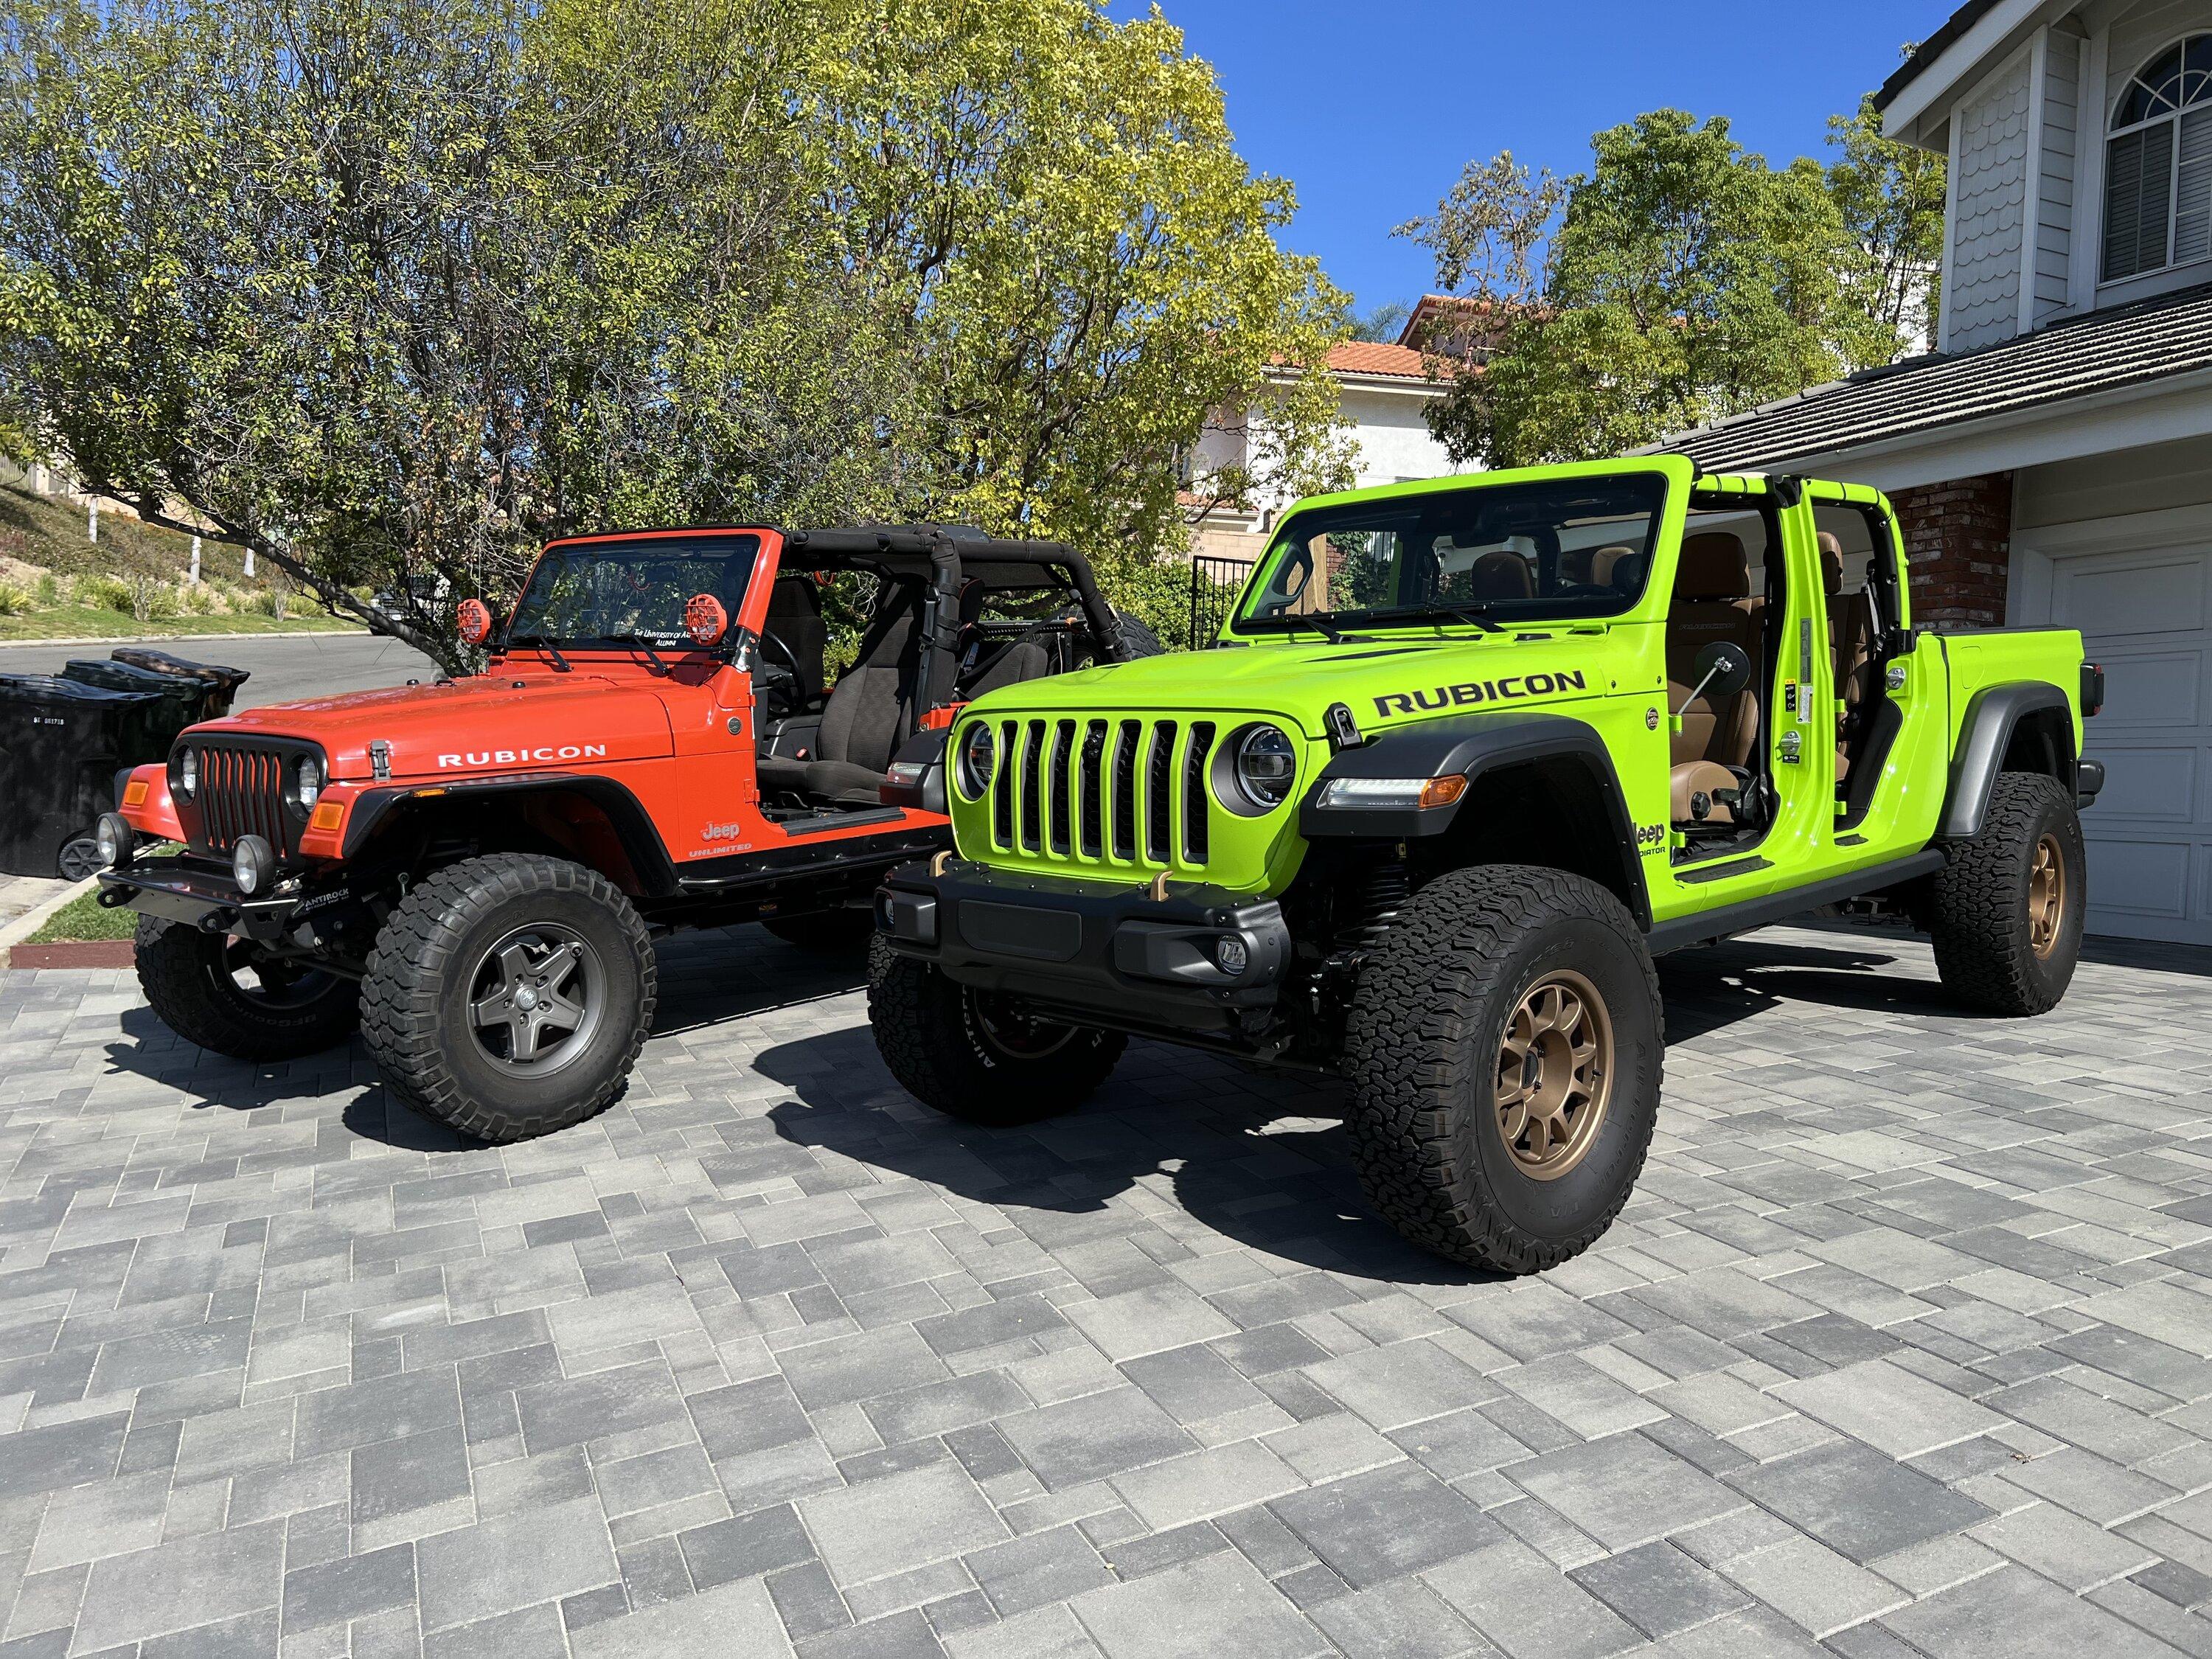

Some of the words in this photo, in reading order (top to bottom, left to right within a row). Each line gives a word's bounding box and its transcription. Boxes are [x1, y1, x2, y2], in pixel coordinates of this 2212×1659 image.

[644, 629, 674, 639] UNIVERSITY
[1371, 669, 1587, 718] RUBICON
[438, 744, 606, 768] RUBICON
[701, 821, 740, 841] Jeep
[689, 843, 752, 858] UNLIMITED
[1638, 846, 1666, 858] DIATOR
[305, 888, 349, 907] ANTIROCK
